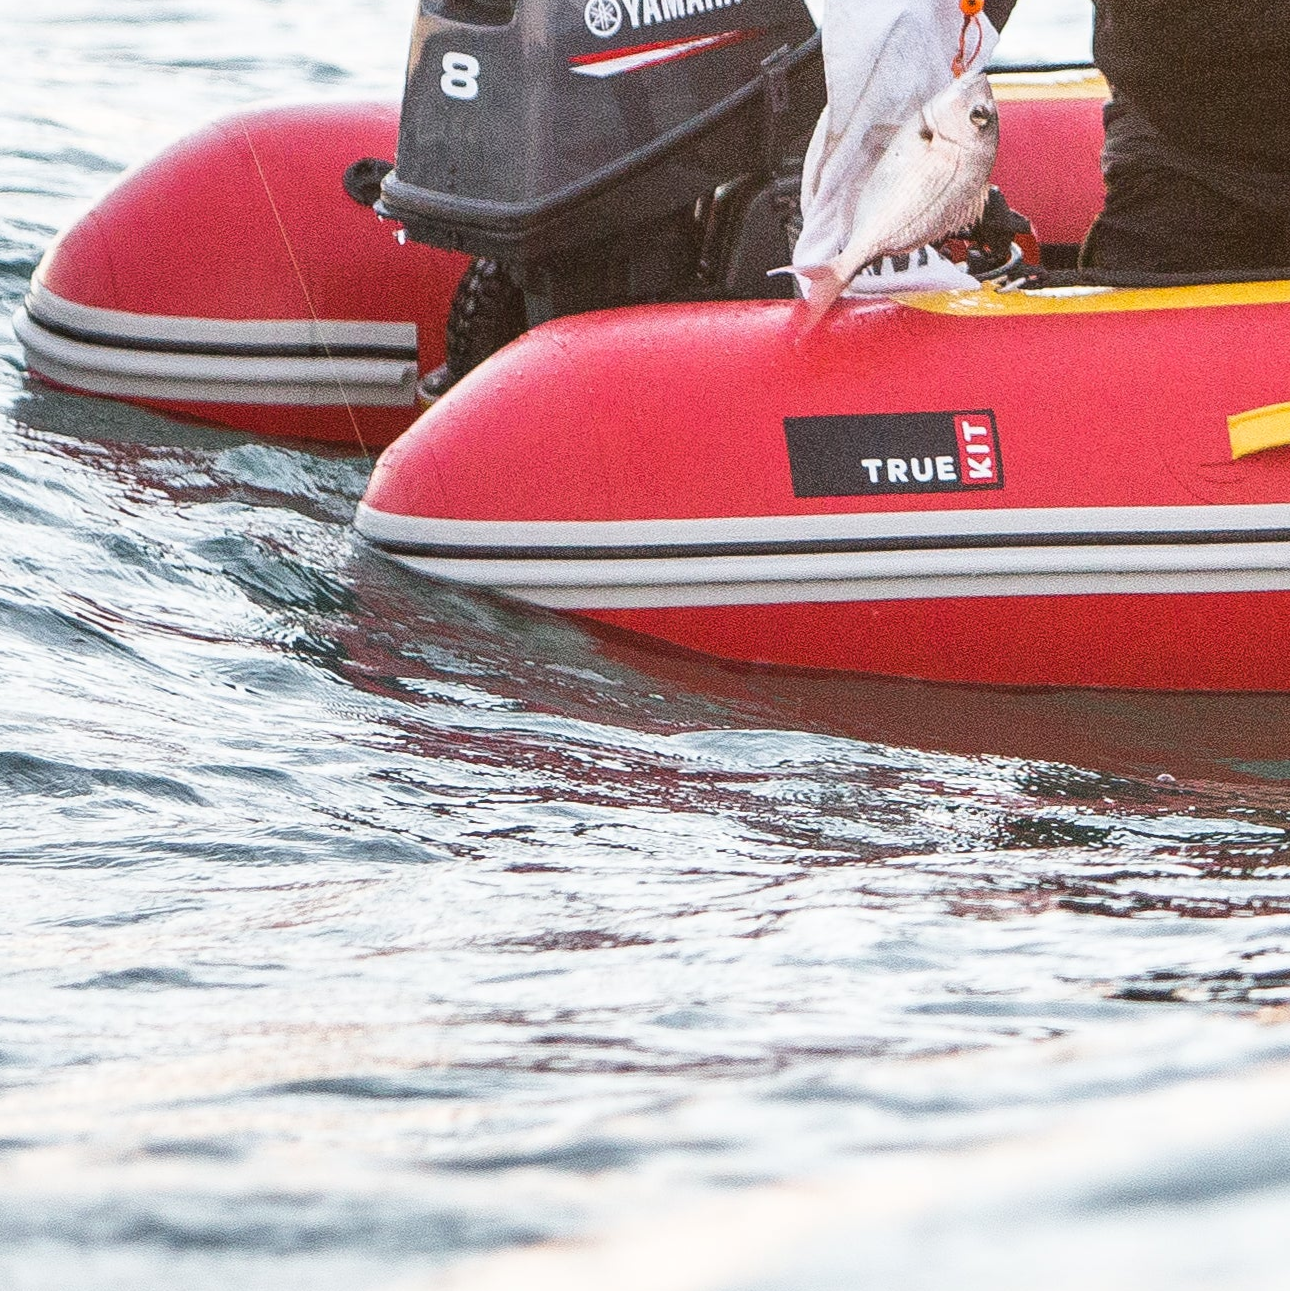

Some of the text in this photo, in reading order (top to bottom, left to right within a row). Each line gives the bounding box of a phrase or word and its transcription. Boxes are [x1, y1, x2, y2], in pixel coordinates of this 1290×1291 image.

[440, 51, 480, 101] 8
[861, 420, 993, 484] TRUE KIT
